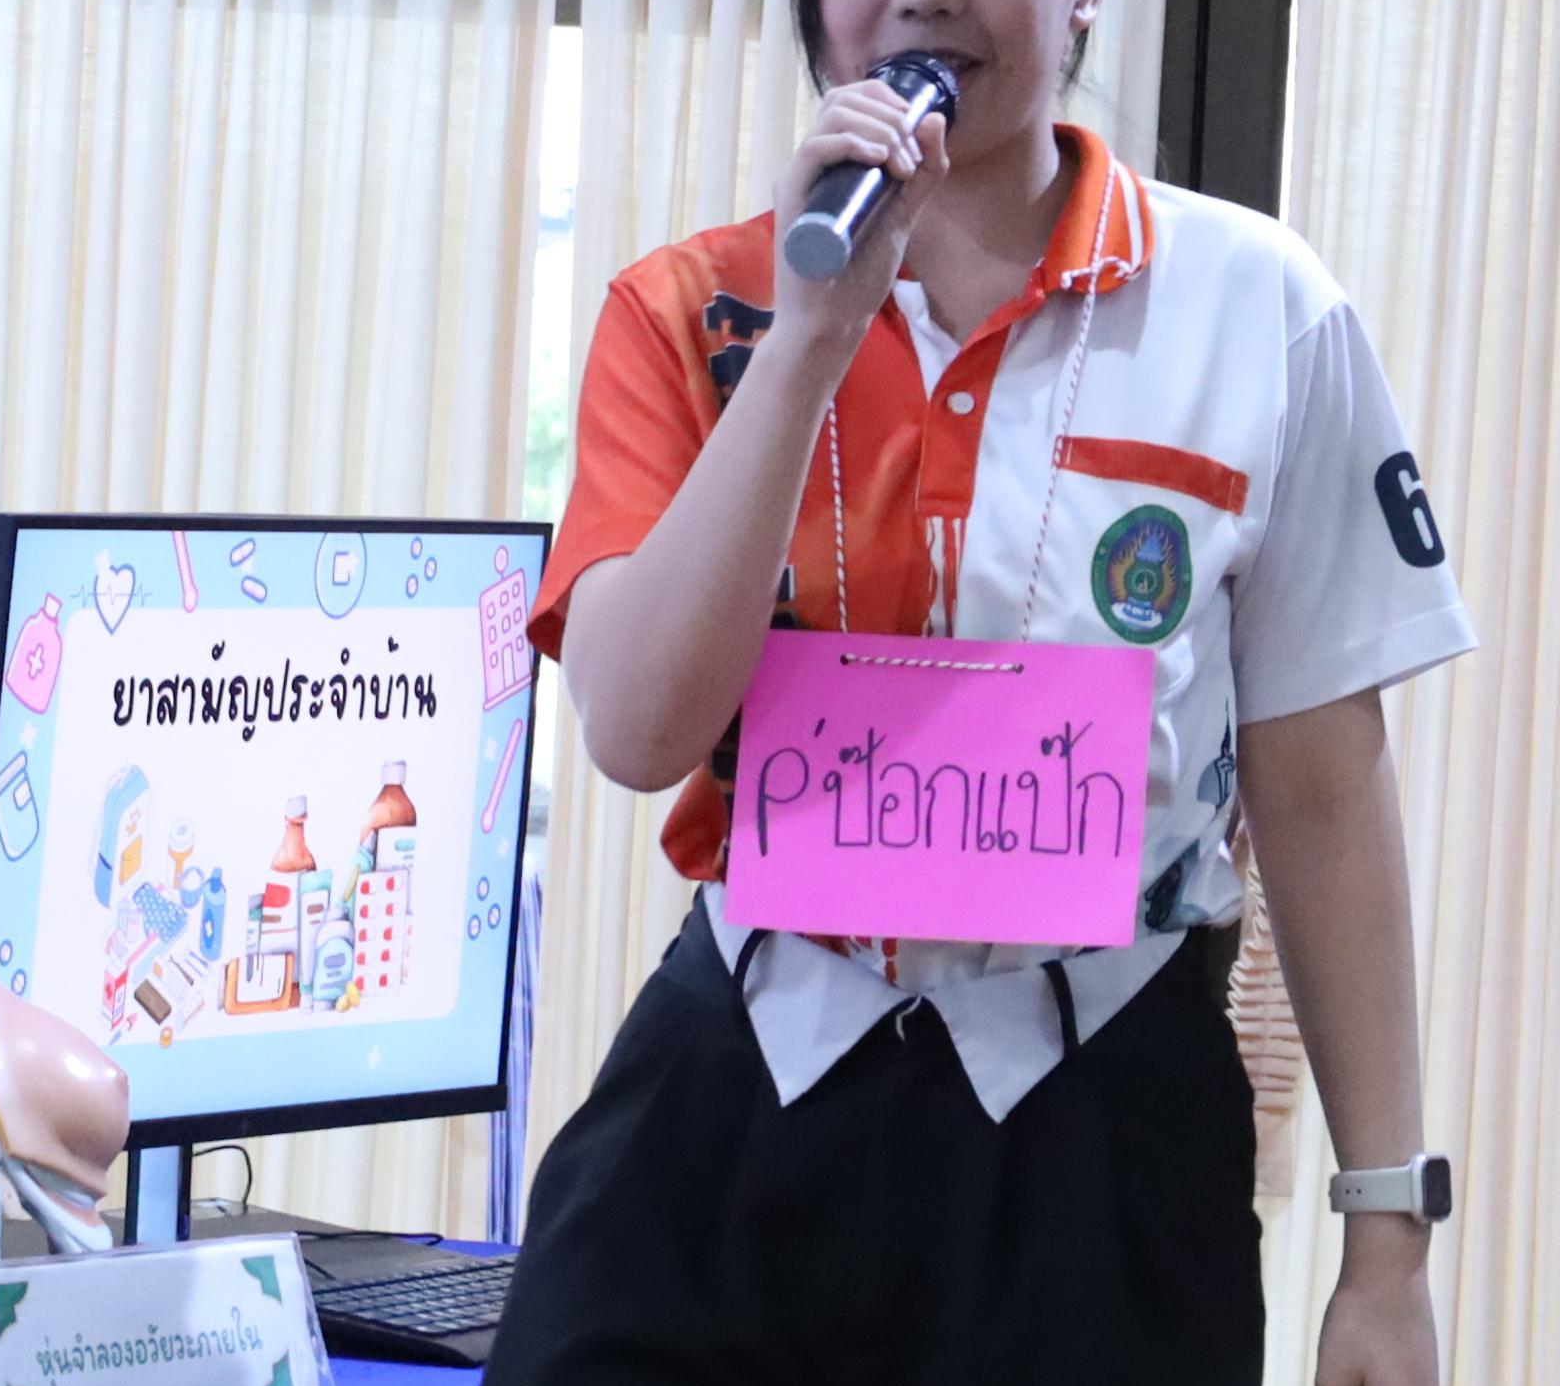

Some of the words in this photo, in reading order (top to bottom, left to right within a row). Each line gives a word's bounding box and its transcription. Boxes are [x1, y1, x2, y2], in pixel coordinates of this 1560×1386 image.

[1374, 450, 1446, 570] 6
[112, 636, 438, 742] ยาสามัญประจำบ้าน
